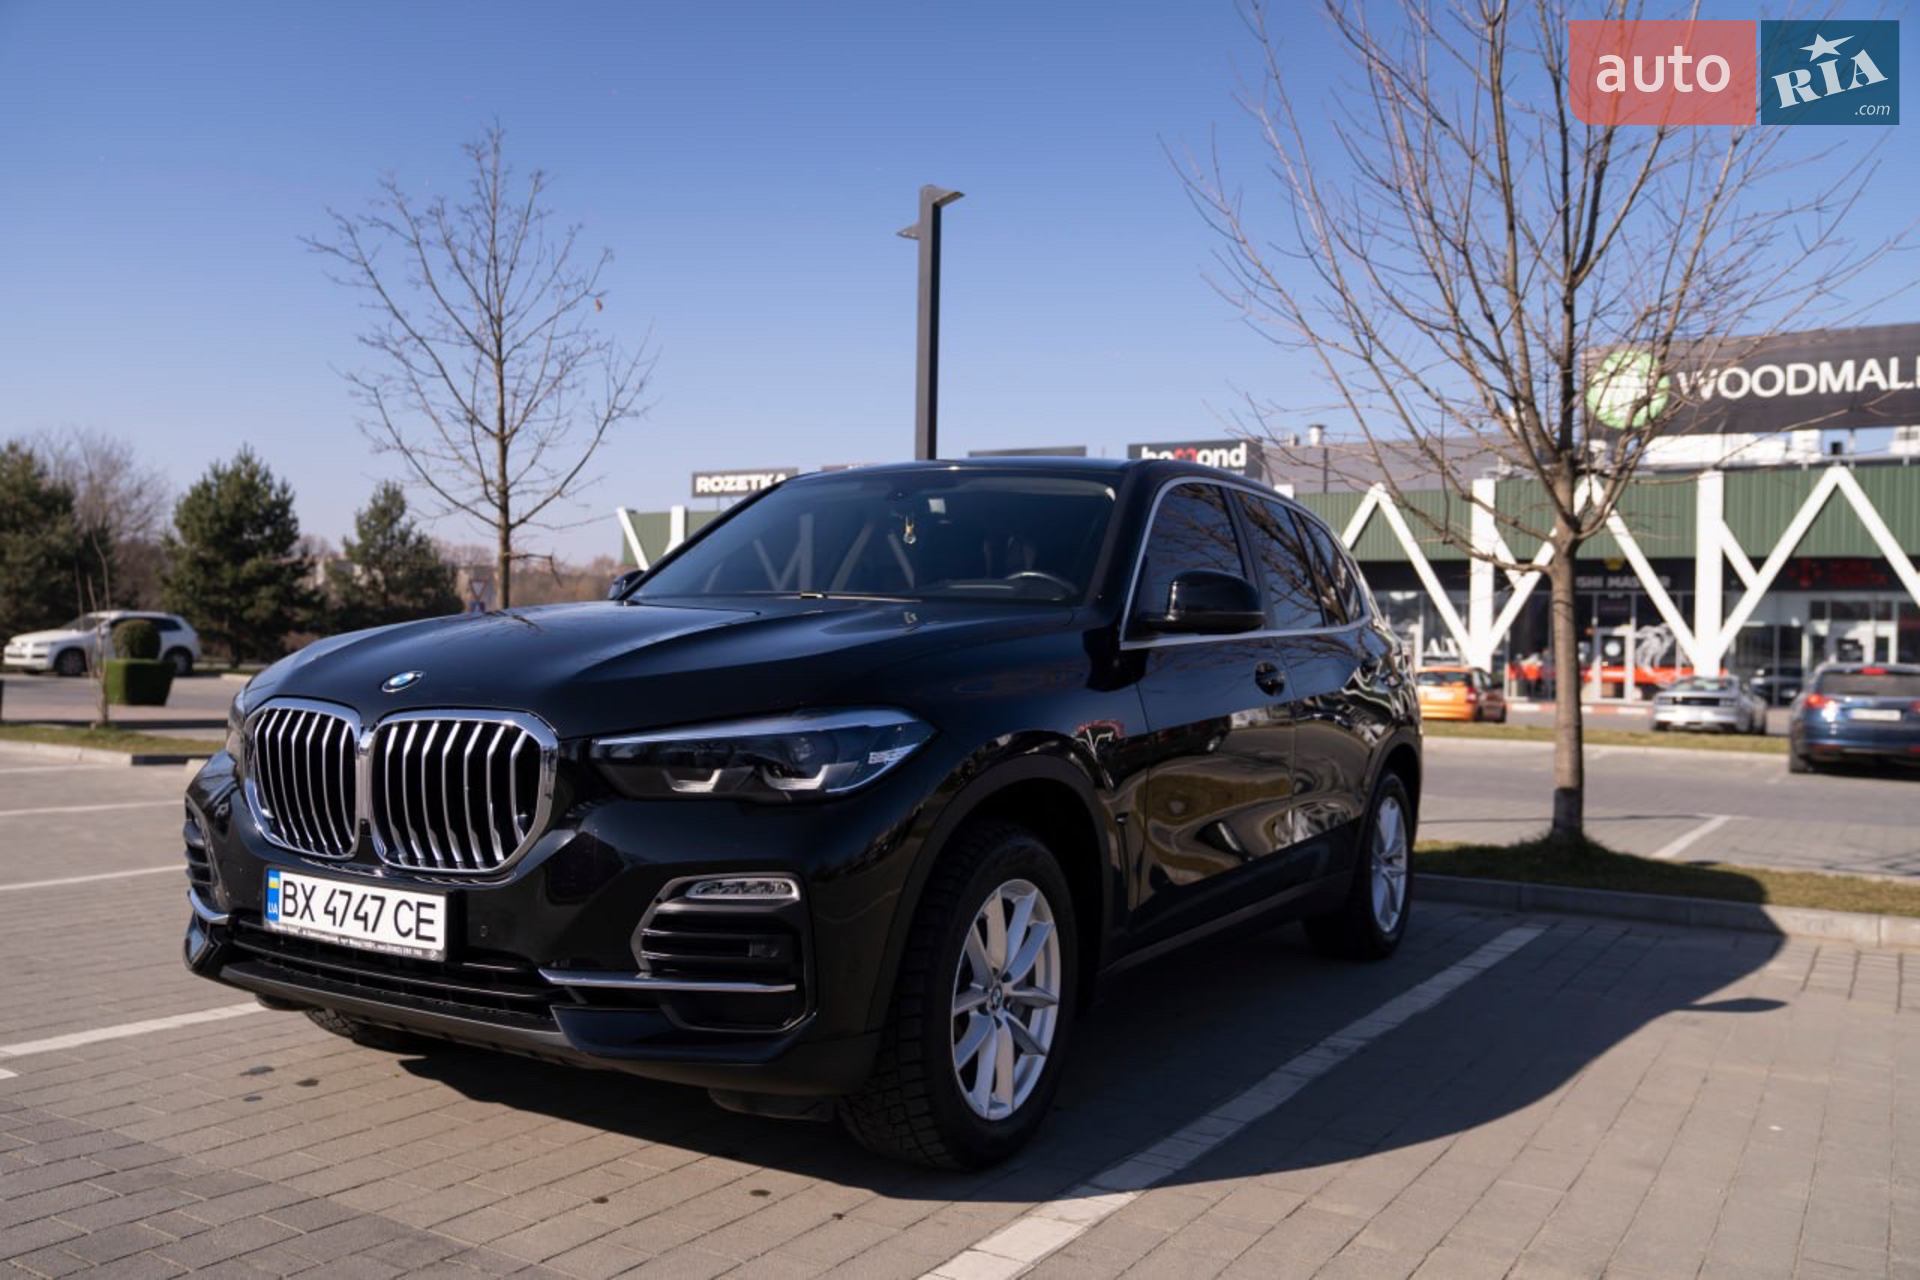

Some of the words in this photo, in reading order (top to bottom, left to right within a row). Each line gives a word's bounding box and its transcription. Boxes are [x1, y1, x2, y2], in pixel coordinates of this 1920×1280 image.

[1676, 356, 1920, 401] WOODMAL
[282, 880, 316, 922] BX
[323, 888, 386, 934] 4747
[393, 899, 437, 943] CE
